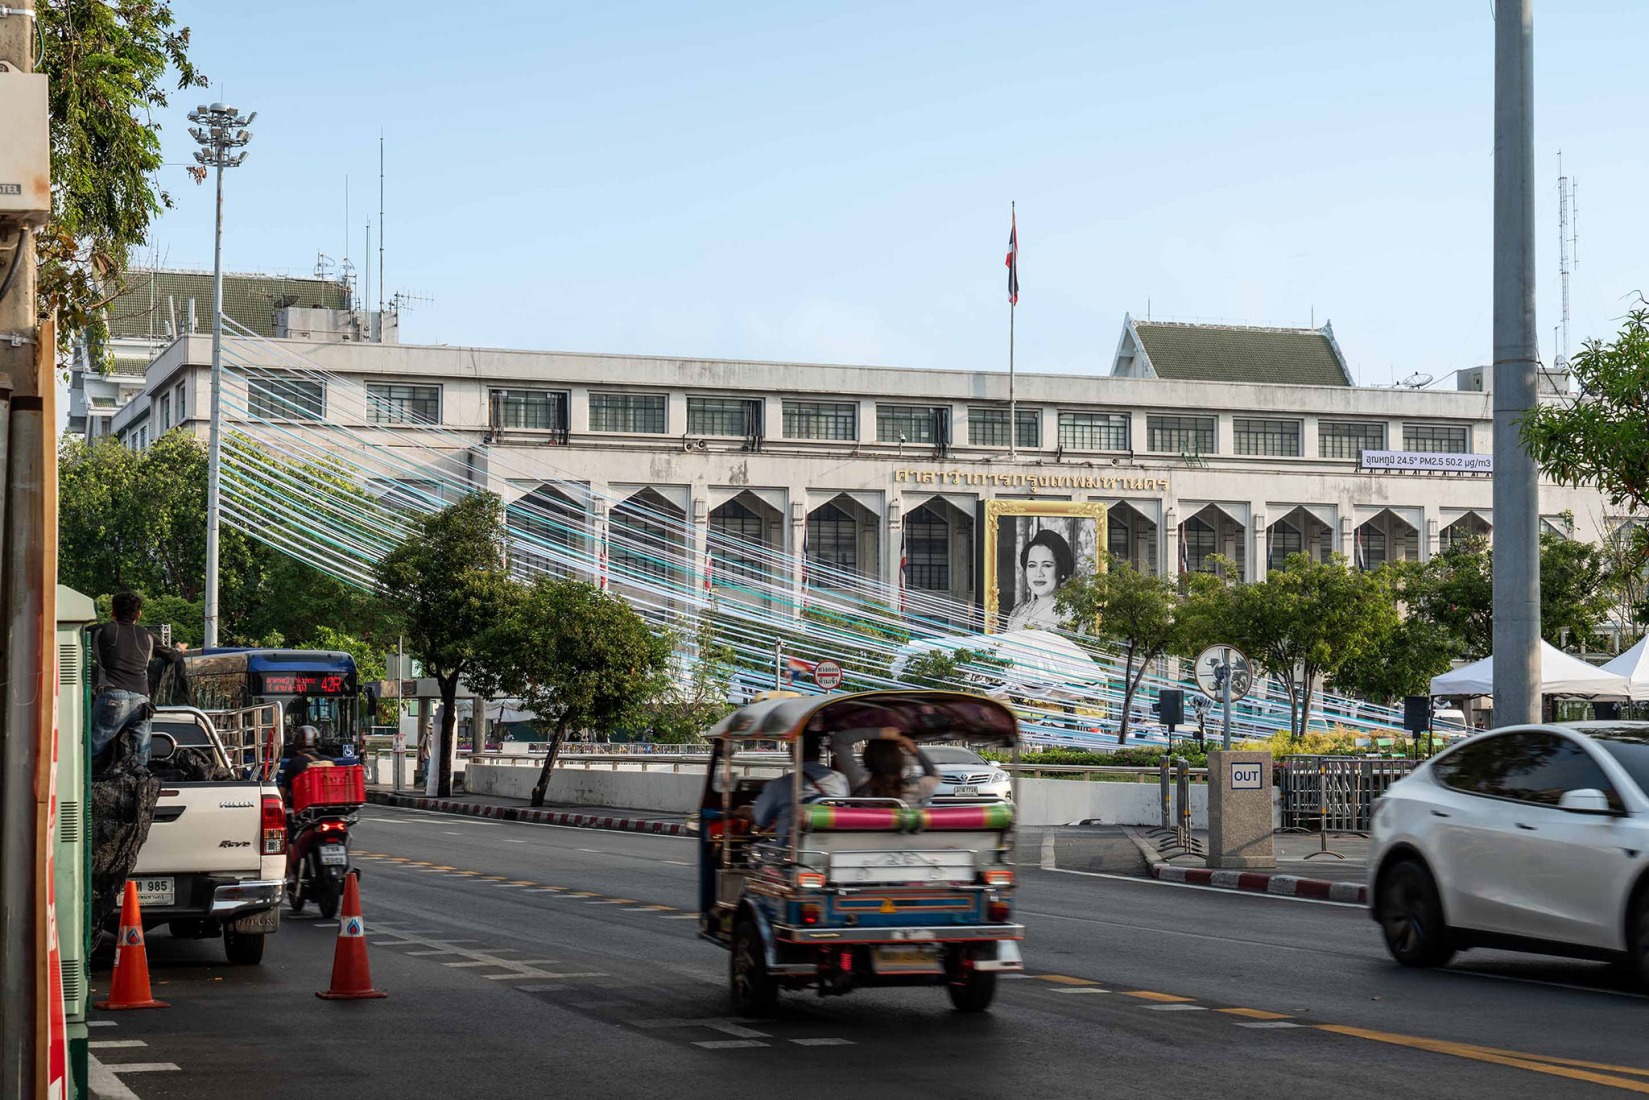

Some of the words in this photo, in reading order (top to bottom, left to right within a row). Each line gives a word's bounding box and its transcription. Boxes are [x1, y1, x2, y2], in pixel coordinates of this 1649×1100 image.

[0, 185, 20, 194] TEL
[1366, 455, 1395, 466] อุณหภูมิ
[1397, 457, 1417, 465] 24.5°
[1420, 458, 1444, 466] PM2.5
[1446, 459, 1463, 467] 50.2
[894, 468, 1171, 493] ศาลาว่าการกรุงเทพมหานคร
[321, 676, 342, 693] 42R
[1234, 771, 1259, 781] OUT
[147, 881, 167, 891] 985
